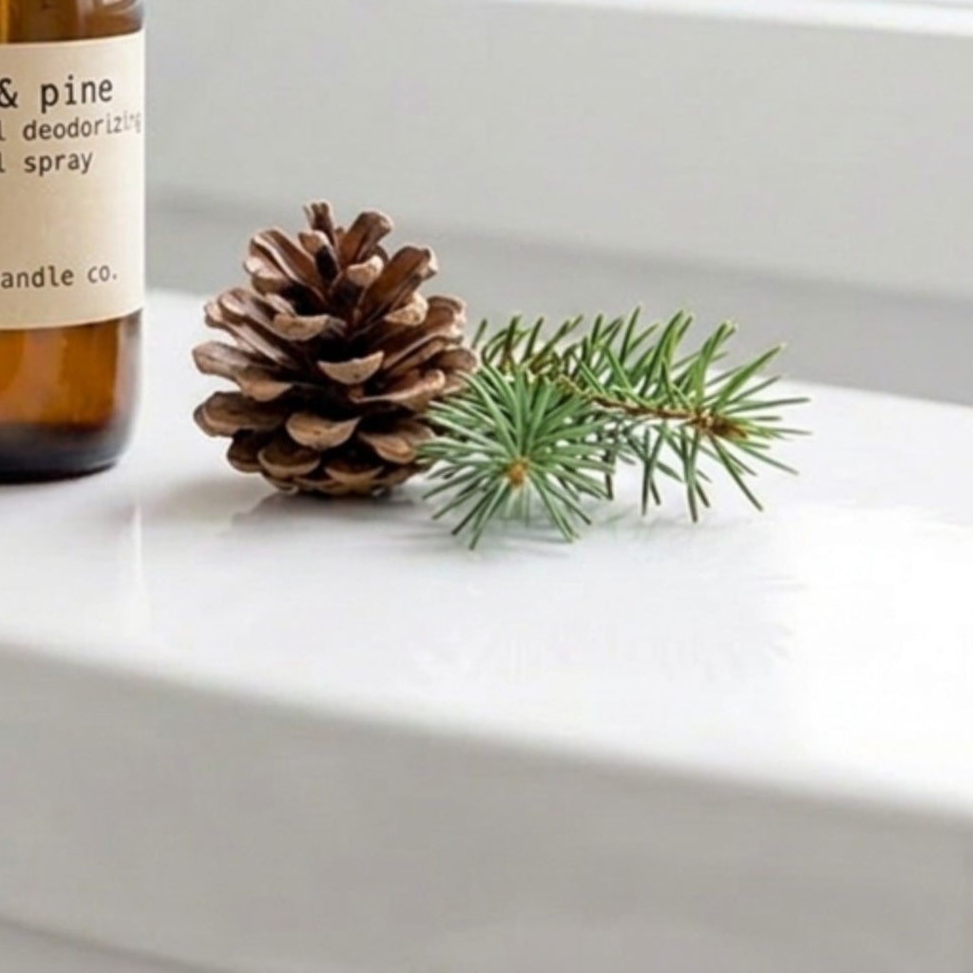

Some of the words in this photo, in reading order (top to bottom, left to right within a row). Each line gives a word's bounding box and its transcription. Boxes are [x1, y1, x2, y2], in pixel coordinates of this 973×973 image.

[41, 74, 114, 113] pine
[23, 152, 94, 177] spray
[87, 265, 118, 284] co.
